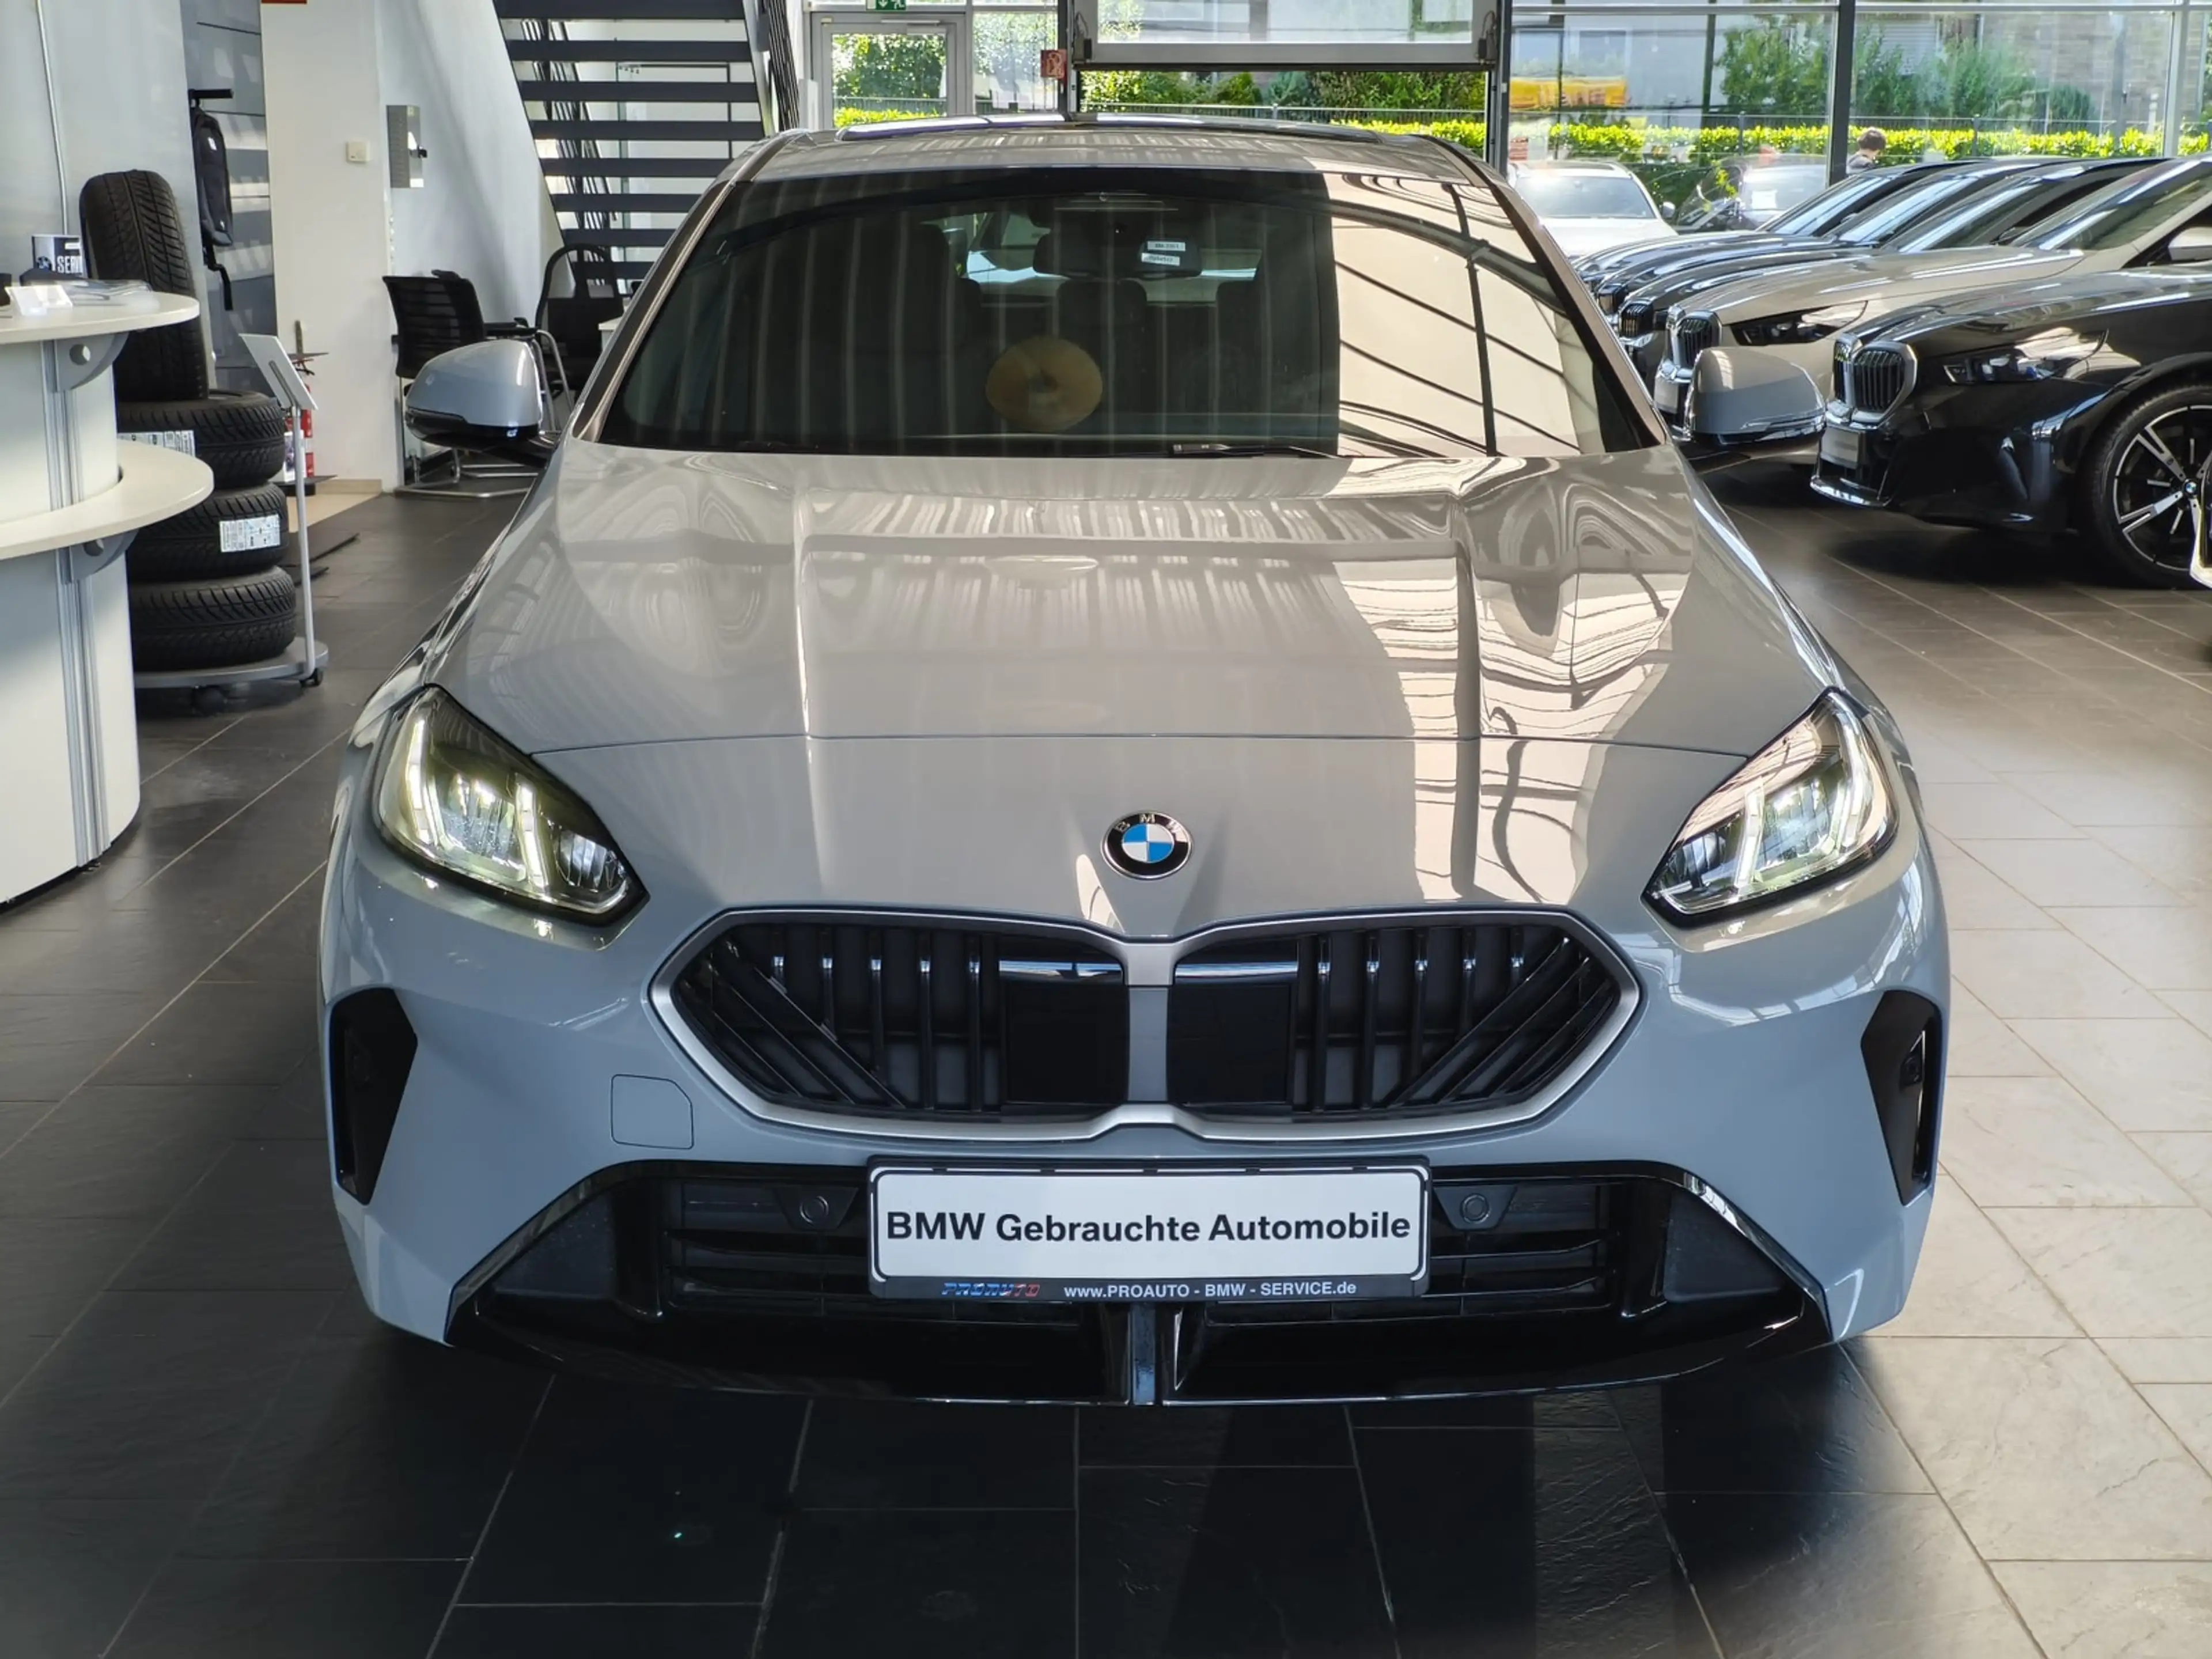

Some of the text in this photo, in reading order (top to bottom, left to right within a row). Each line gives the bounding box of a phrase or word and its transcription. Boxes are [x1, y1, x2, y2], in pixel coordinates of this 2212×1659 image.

[1115, 813, 1182, 834] BMW
[887, 1211, 1410, 1242] BMW Gebrauchte Automobile
[941, 1282, 1040, 1297] PROAUTO
[1064, 1284, 1190, 1298] www.PROAUTO
[1205, 1283, 1246, 1297] BMW
[1260, 1281, 1357, 1296] SERVICE.de
